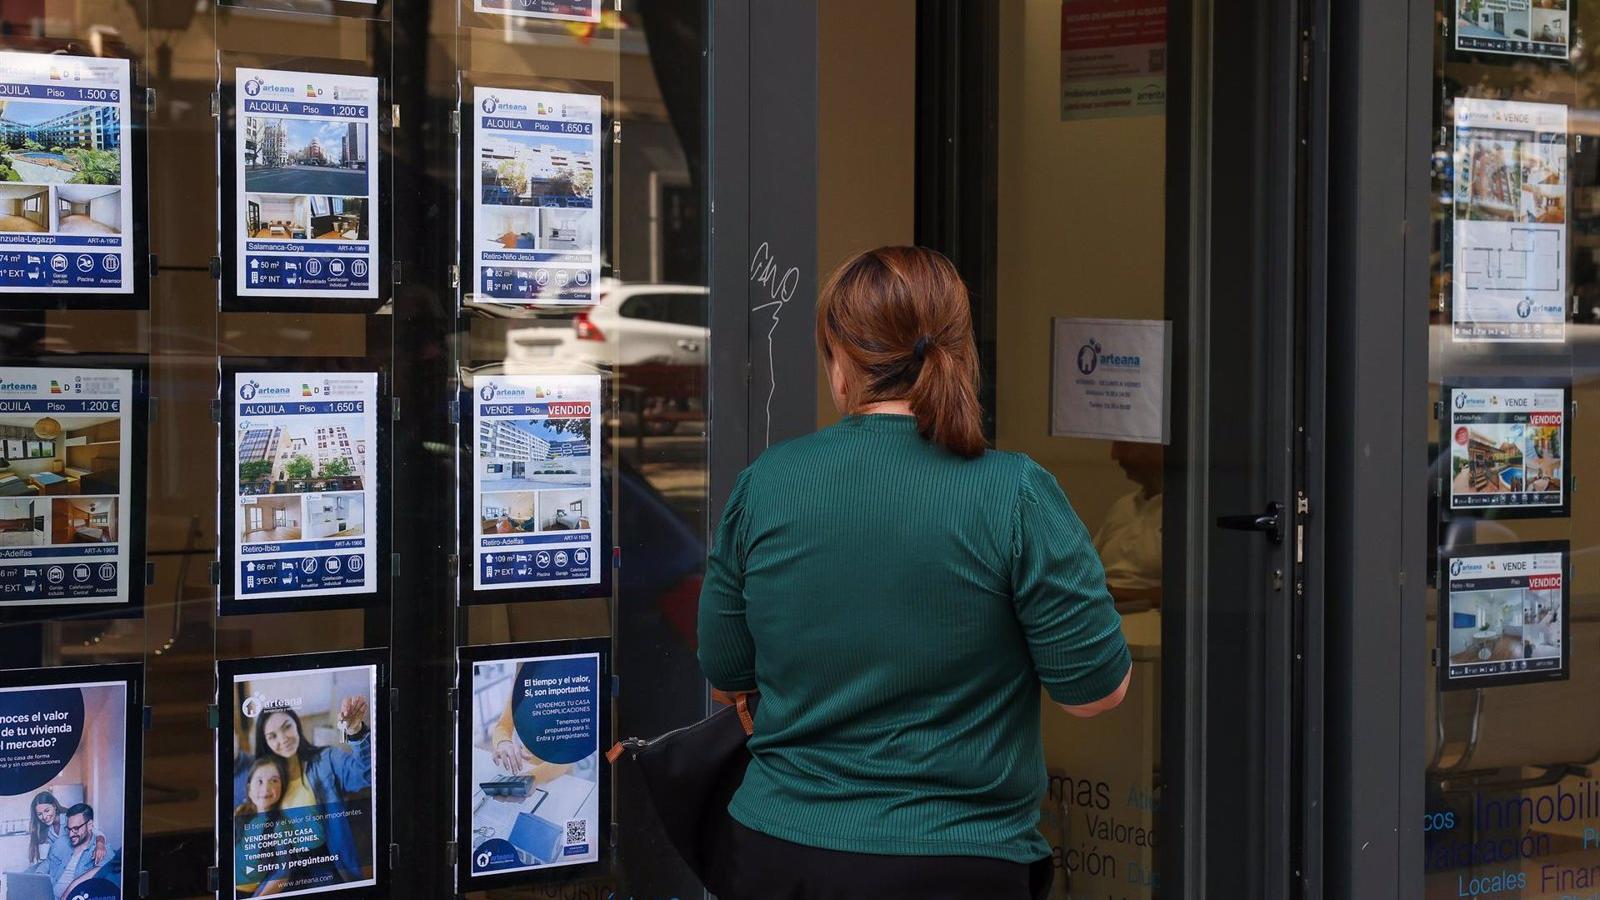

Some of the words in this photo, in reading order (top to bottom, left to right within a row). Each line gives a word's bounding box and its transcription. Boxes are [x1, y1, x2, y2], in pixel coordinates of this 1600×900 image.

[0, 84, 31, 96] QUILA
[46, 88, 65, 98] Piso
[79, 89, 107, 100] 1.500
[109, 90, 118, 100] €
[262, 84, 295, 94] arteana
[317, 88, 323, 96] D
[249, 101, 289, 113] ALQUILA
[302, 105, 320, 114] Piso
[331, 105, 356, 117] 1.200
[358, 107, 365, 117] €
[497, 102, 528, 111] arteana
[1503, 113, 1530, 124] VENDE
[486, 119, 523, 129] ALQUILA
[534, 122, 550, 131] Piso
[560, 123, 583, 133] 1.650
[584, 124, 590, 134] €
[248, 242, 305, 252] Salamanca-Goya
[482, 252, 517, 261] Retiro-Niño
[517, 253, 536, 262] Jesús
[260, 261, 270, 269] 50
[270, 260, 280, 269] m²
[9, 270, 24, 278] EXT
[268, 275, 281, 283] INT
[501, 283, 513, 291] INT
[1100, 353, 1141, 367] arteana
[1, 382, 37, 391] arteana
[64, 383, 70, 392] D
[258, 387, 291, 395] arteana
[496, 388, 525, 396] arteana
[0, 401, 31, 412] QUILA
[46, 402, 66, 411] Piso
[80, 400, 109, 411] 1.200
[111, 401, 118, 411] €
[1504, 397, 1529, 408] VENDE
[245, 405, 286, 415] ALQUILA
[299, 404, 316, 413] Piso
[329, 402, 354, 413] 1.650
[356, 402, 363, 412] €
[485, 405, 514, 415] VENDE
[525, 406, 540, 414] Piso
[547, 404, 592, 416] VENDIDO
[1529, 415, 1562, 426] VENDIDO
[482, 538, 525, 547] Retiro-Adelfas
[242, 545, 281, 554] Retiro-Ibiza
[527, 553, 533, 562] 2
[501, 567, 514, 576] EXT
[527, 567, 533, 575] 2
[1502, 561, 1527, 571] VENDE
[7, 568, 18, 577] m²
[1529, 576, 1561, 588] VENDIDO
[4, 583, 21, 593] EXT
[524, 679, 532, 687] El
[532, 677, 557, 689] tiempo
[558, 678, 563, 686] y
[563, 676, 571, 684] el
[571, 674, 591, 684] valor,
[534, 689, 547, 697] son
[548, 685, 591, 696] importantes.
[263, 697, 302, 709] arteana
[534, 701, 566, 710] VENDEMOS
[574, 699, 591, 707] CASA
[542, 705, 591, 717] COMPLICACIONES
[0, 714, 29, 724] noces
[31, 711, 41, 722] el
[43, 710, 69, 721] valor
[556, 718, 580, 726] Tenemos
[580, 717, 591, 725] una
[1, 727, 15, 737] de
[16, 726, 28, 736] tu
[30, 723, 72, 735] vivienda
[544, 726, 572, 735] propuesta
[571, 725, 583, 734] para
[6, 737, 57, 750] mercado?
[536, 735, 551, 743] Entra
[21, 758, 61, 768] complicaciones
[1049, 775, 1110, 810] mas
[251, 821, 275, 831] tiempo
[312, 813, 325, 821] son
[244, 831, 282, 843] VENDEMOS
[284, 829, 294, 837] TU
[294, 827, 314, 837] CASA
[244, 842, 256, 851] SIN
[257, 834, 319, 849] COMPLICACIONES.
[244, 851, 274, 861] Tenemos
[275, 848, 288, 857] una
[288, 845, 310, 855] oferta.
[257, 863, 280, 873] Entra
[281, 862, 287, 870] y
[288, 853, 339, 870] pregúntanos
[277, 873, 334, 888] www.arteana.com
[1458, 869, 1527, 897] Locales
